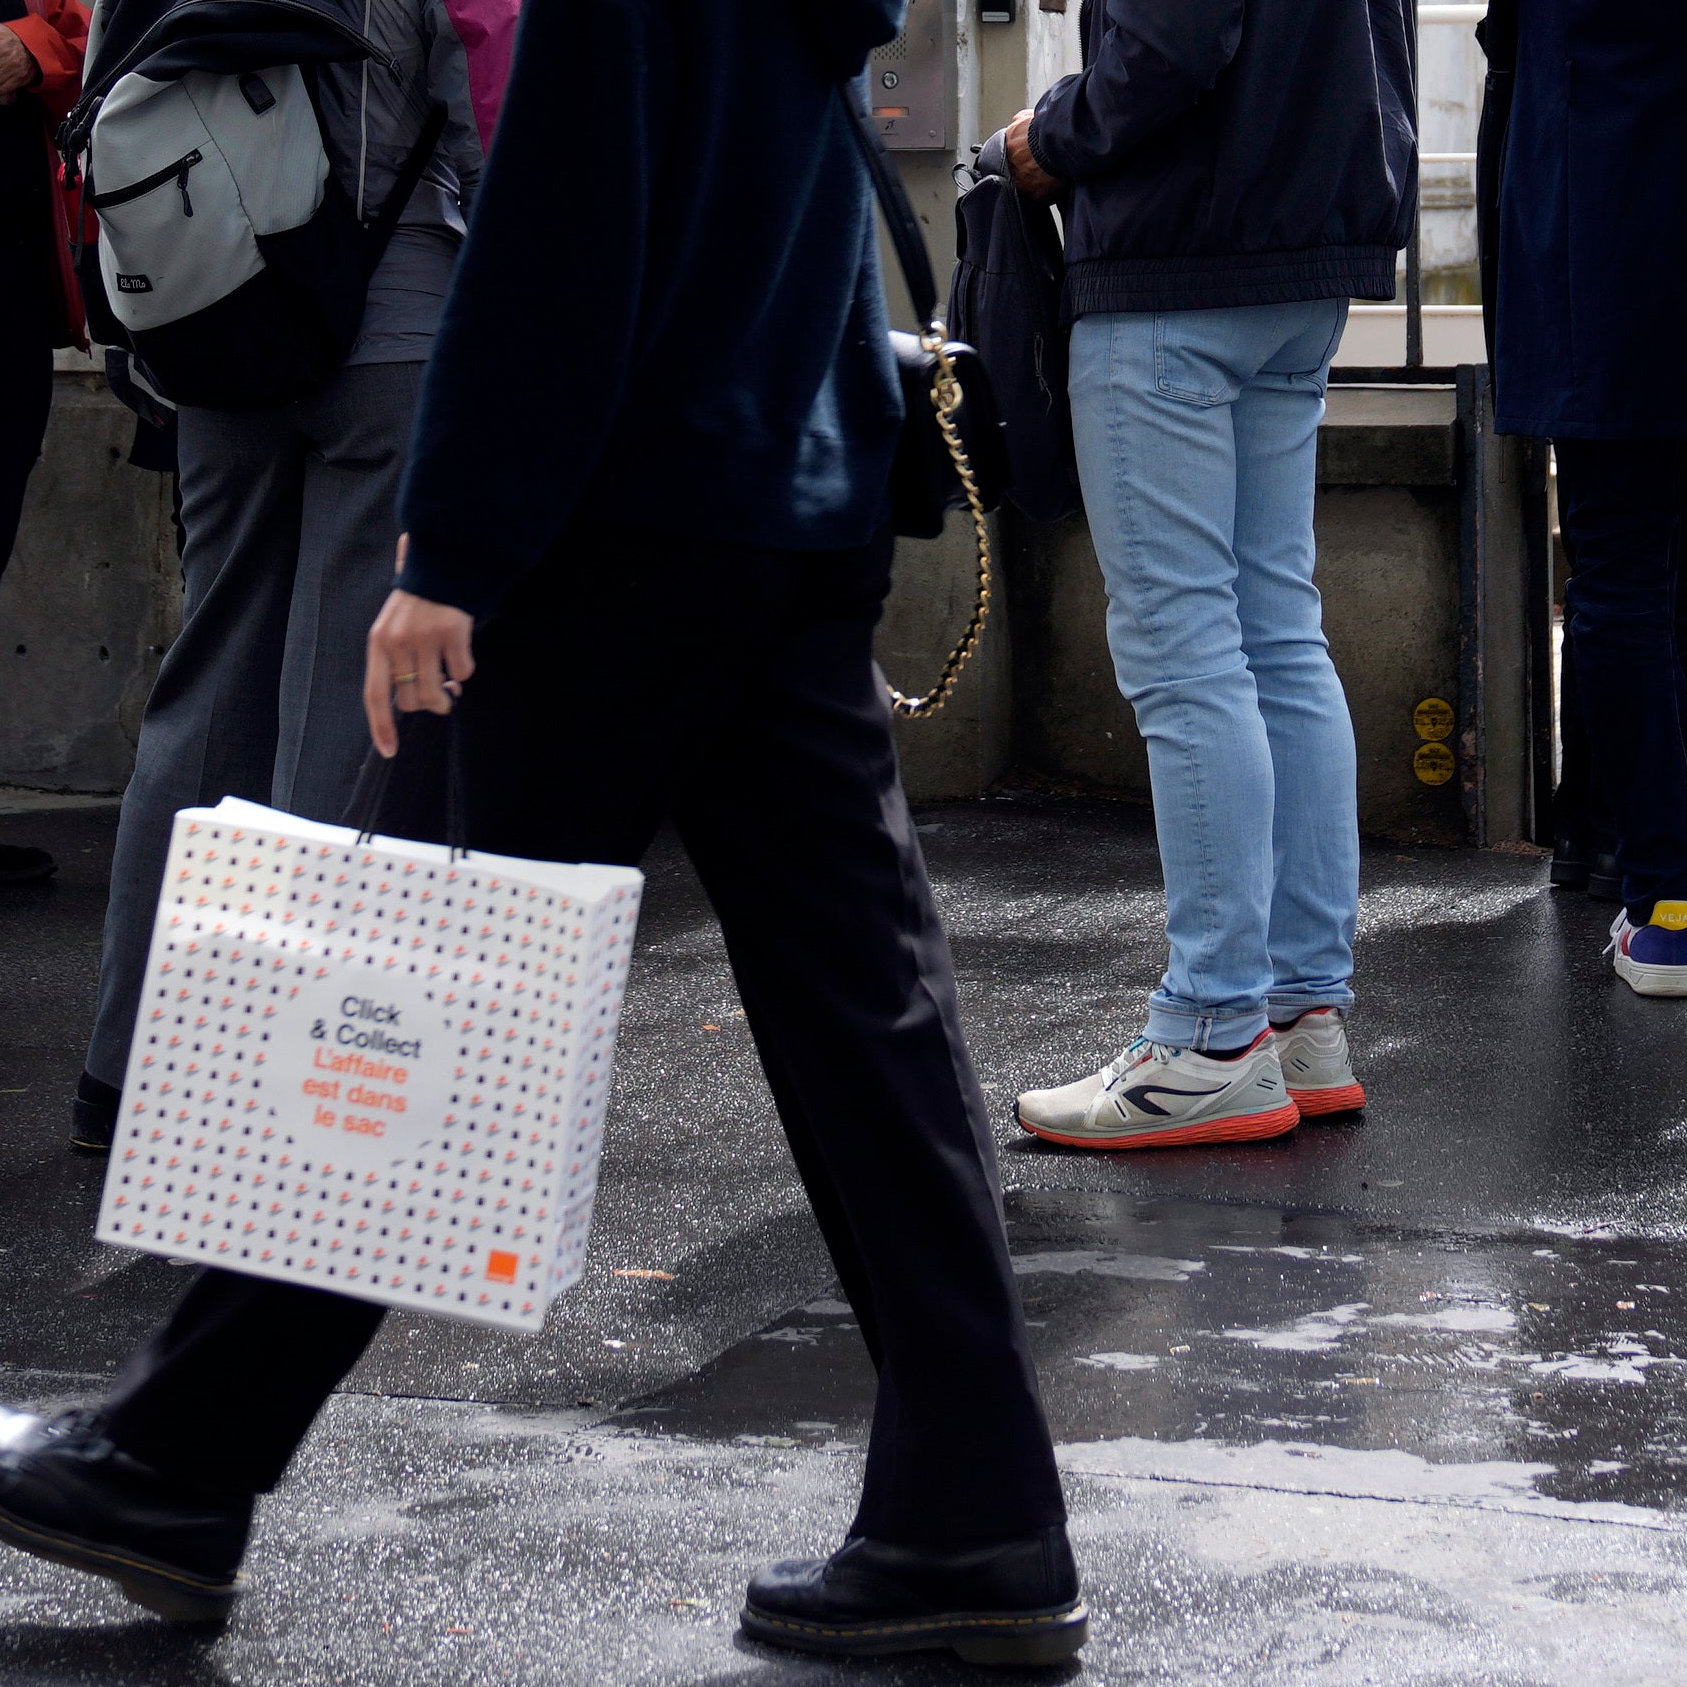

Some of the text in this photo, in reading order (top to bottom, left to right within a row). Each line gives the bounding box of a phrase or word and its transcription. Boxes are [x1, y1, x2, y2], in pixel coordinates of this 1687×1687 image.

[341, 996, 403, 1026] Click
[310, 1018, 423, 1059] & Collect
[313, 1047, 410, 1085] L'affaire
[302, 1077, 409, 1114] est dans
[313, 1103, 387, 1138] le sac
